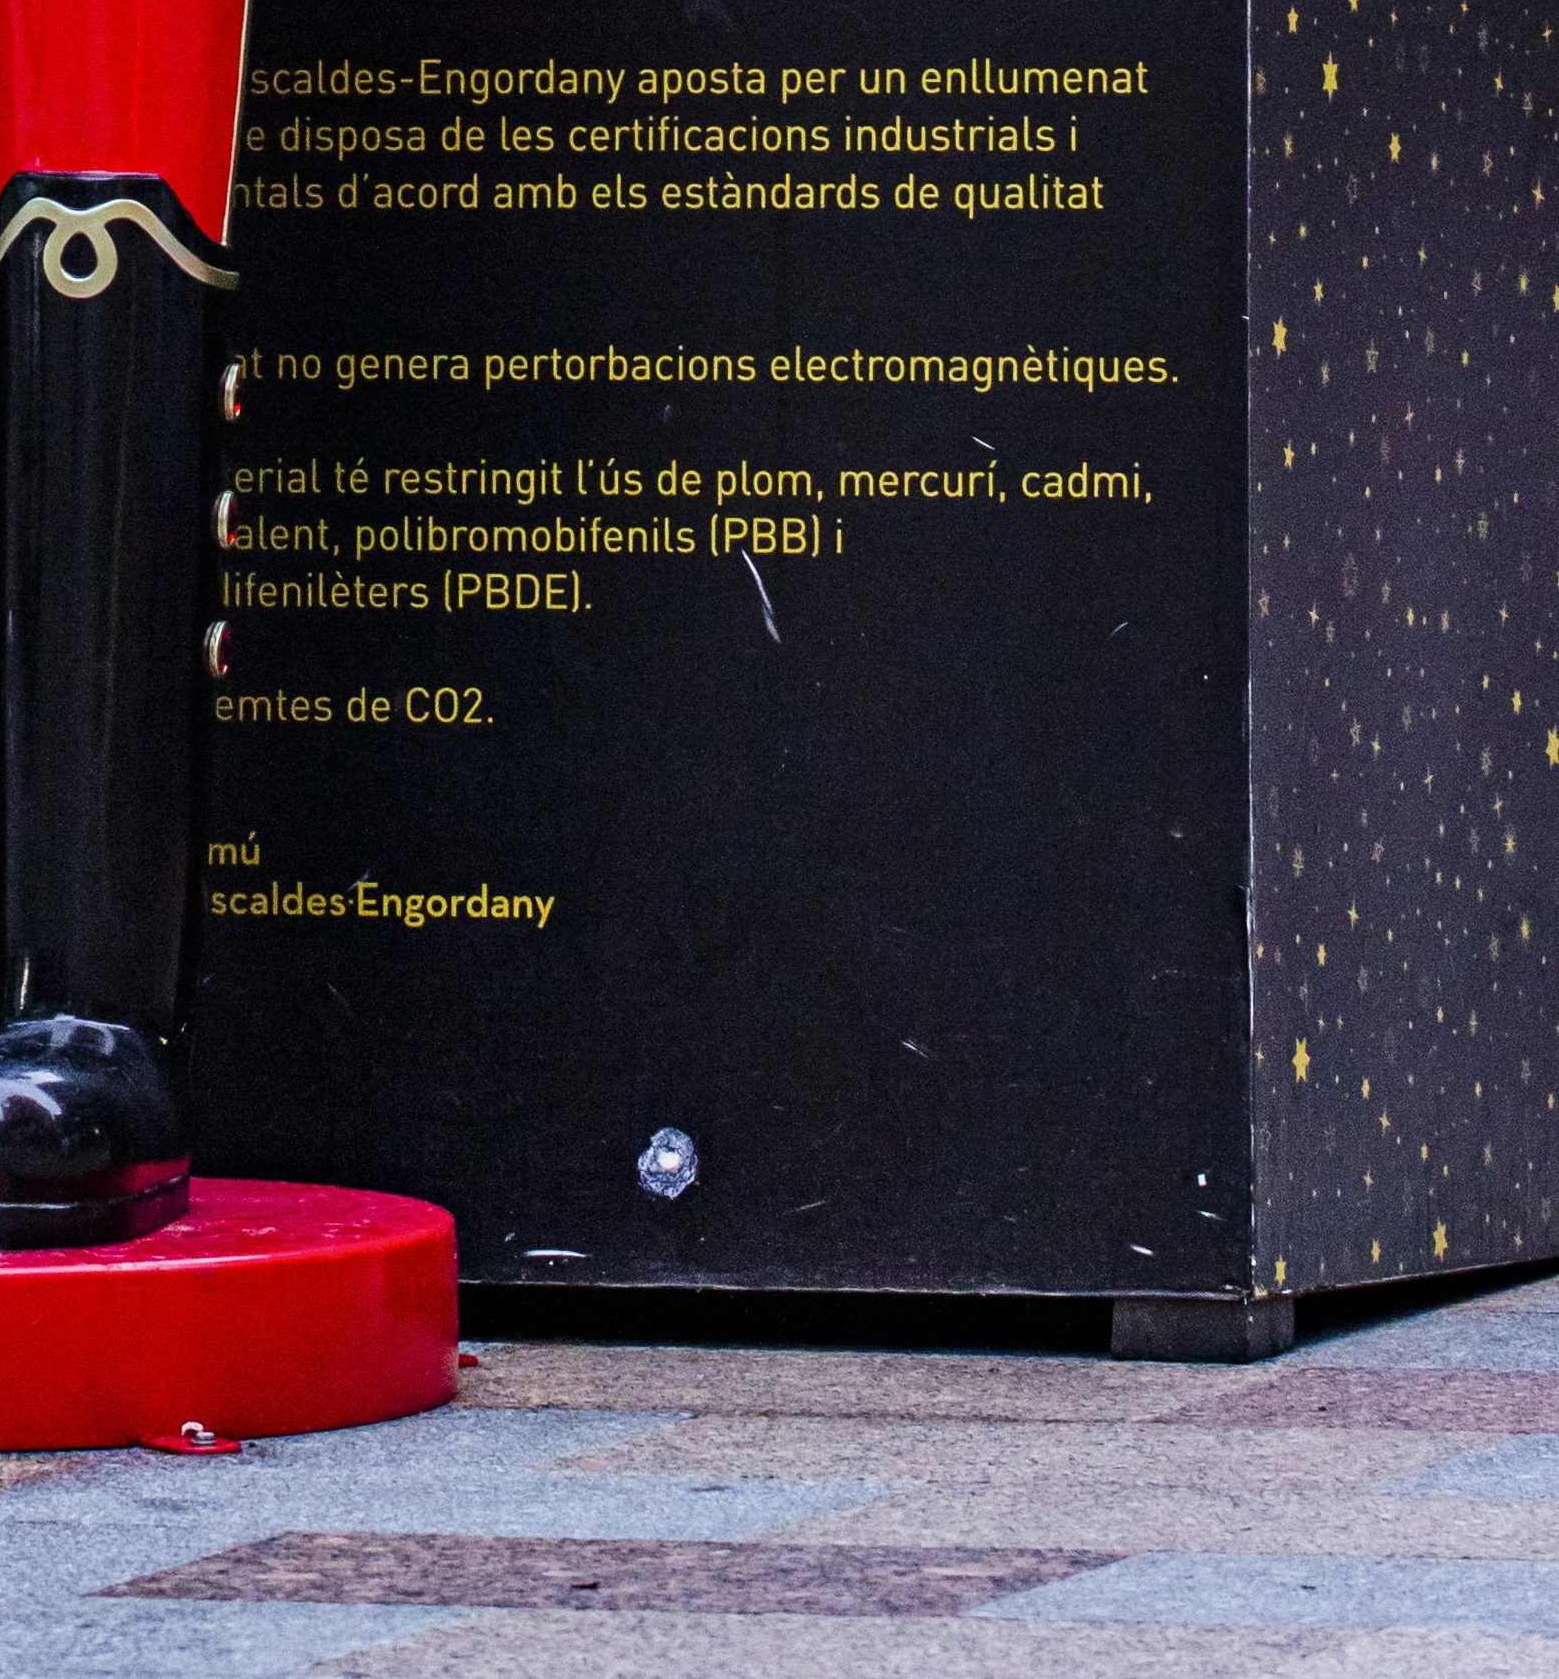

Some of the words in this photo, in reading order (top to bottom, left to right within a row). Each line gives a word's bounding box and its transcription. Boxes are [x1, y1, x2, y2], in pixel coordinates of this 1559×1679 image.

[250, 58, 625, 104] scaldes-Engordany
[638, 62, 766, 104] aposta
[782, 68, 846, 104] per
[860, 68, 906, 94] un
[921, 58, 1147, 94] enllumenat
[280, 117, 426, 161] disposa
[441, 116, 485, 152] de
[501, 116, 554, 152] les
[569, 116, 830, 152] certificacions
[845, 116, 1055, 152] industrials
[1070, 115, 1077, 151] i
[493, 173, 577, 209] amb
[591, 173, 647, 209] els
[662, 171, 880, 209] estàndards
[894, 173, 939, 209] de
[954, 173, 1103, 219] qualitat
[278, 354, 321, 380] no
[336, 354, 469, 390] genera
[485, 345, 756, 390] pertorbacions
[770, 345, 1178, 393] electromagnètiques.
[335, 457, 369, 494] té
[385, 459, 562, 505] restringit
[657, 460, 702, 496] de
[717, 460, 823, 506] plom,
[840, 460, 1006, 503] mercurí,
[1022, 462, 1151, 503] cadmi,
[356, 516, 696, 560] polibromobifenils
[710, 514, 821, 557] (PBB)
[836, 518, 842, 554] i
[444, 570, 591, 612] (PBDE).
[216, 690, 332, 722] emtes
[347, 687, 390, 722] de
[406, 687, 493, 724] CO2.
